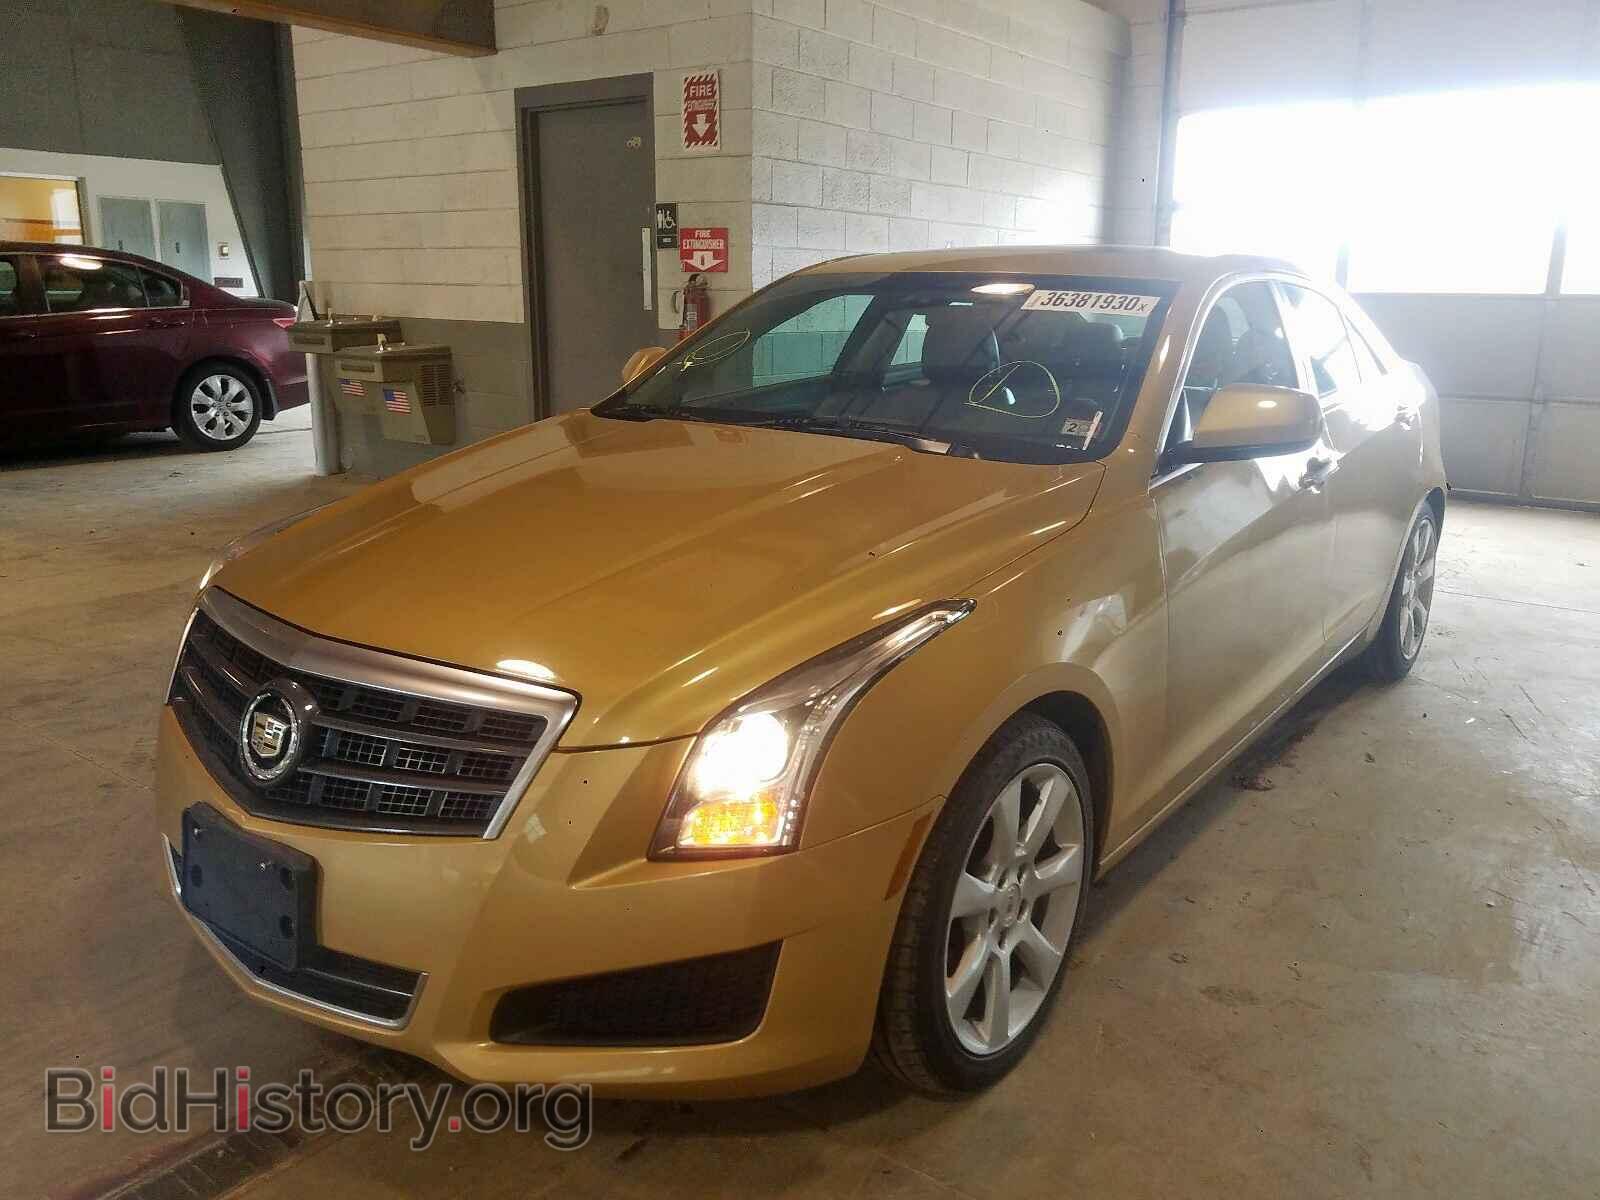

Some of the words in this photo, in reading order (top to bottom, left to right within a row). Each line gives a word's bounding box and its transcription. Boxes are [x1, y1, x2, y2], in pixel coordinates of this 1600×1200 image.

[689, 84, 713, 97] FIRE
[694, 229, 711, 238] FIRE
[1040, 291, 1140, 312] 36381930
